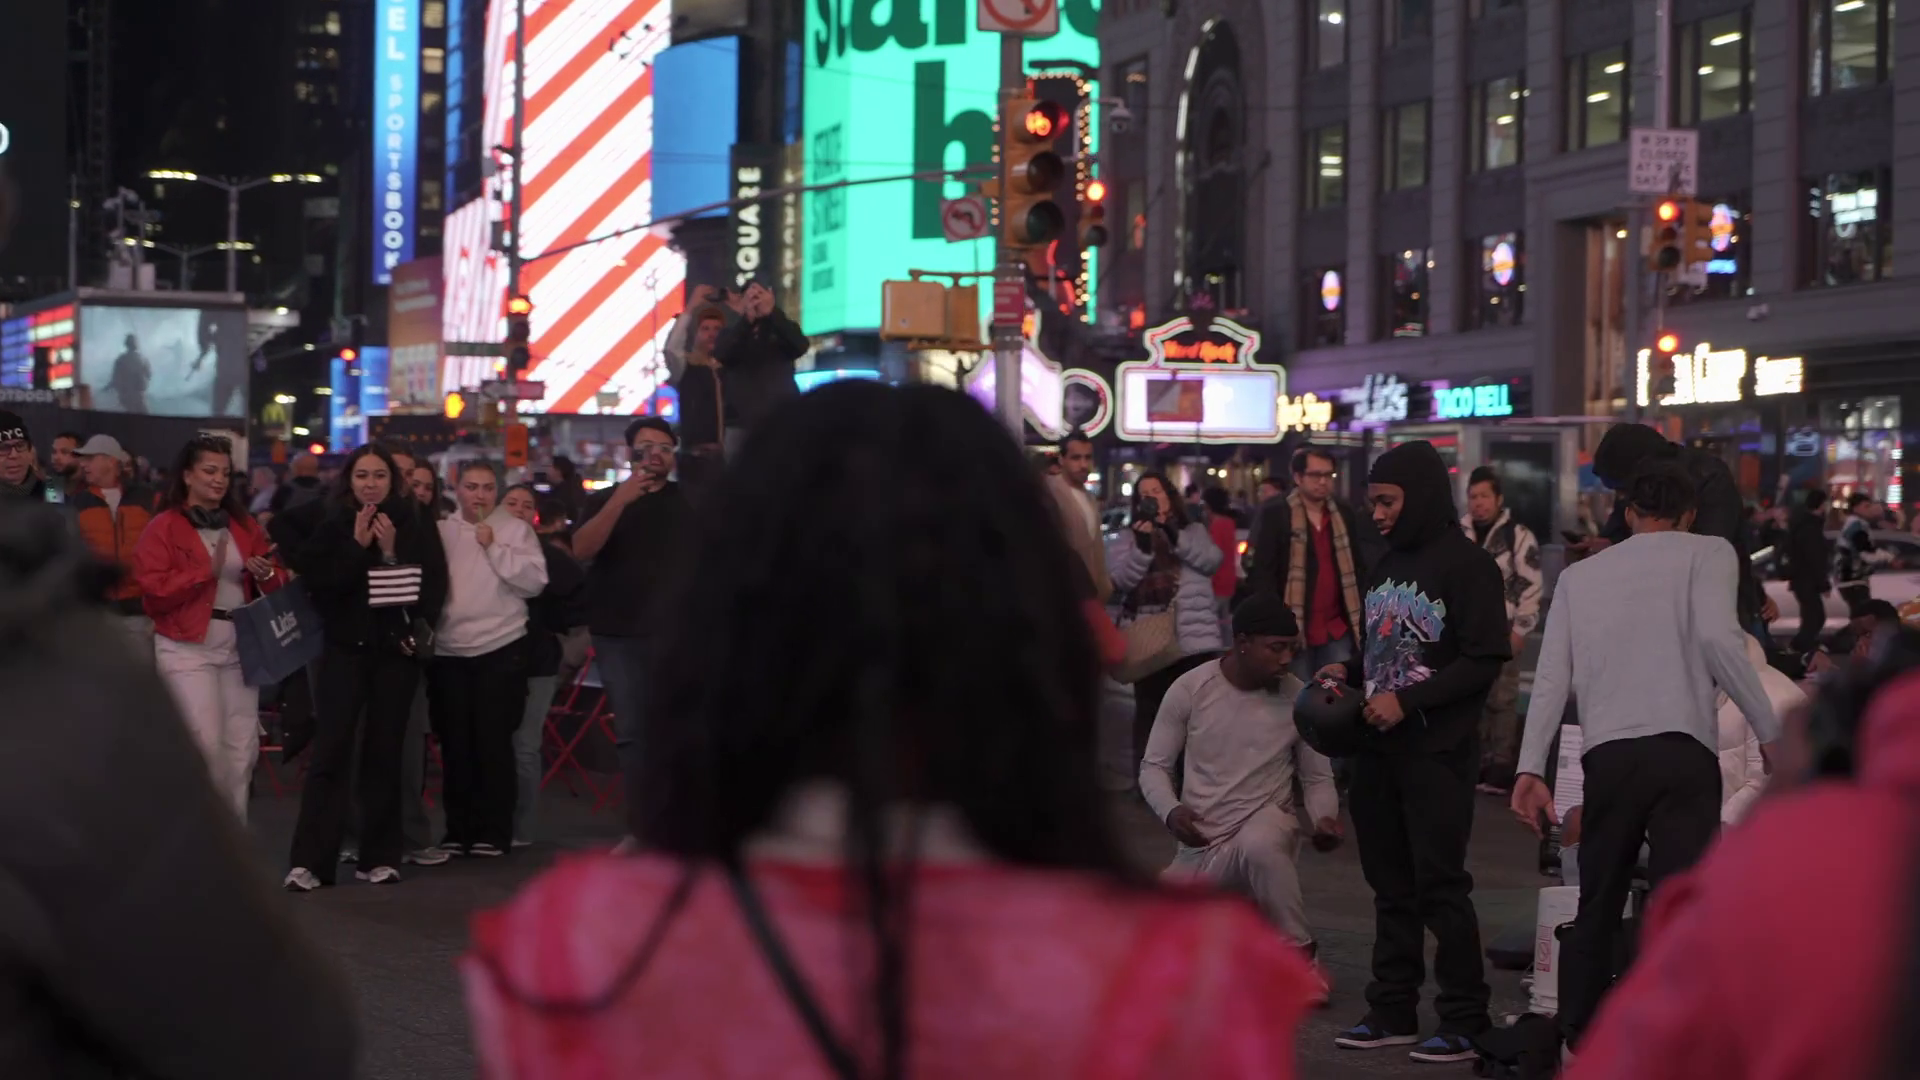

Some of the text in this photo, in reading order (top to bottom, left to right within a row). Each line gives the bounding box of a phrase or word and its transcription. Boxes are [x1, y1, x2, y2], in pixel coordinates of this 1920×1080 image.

[386, 0, 406, 60] EL
[383, 73, 404, 270] SPORTSBOOK
[1639, 148, 1689, 161] CLOSED
[1433, 384, 1513, 418] TACO BELL
